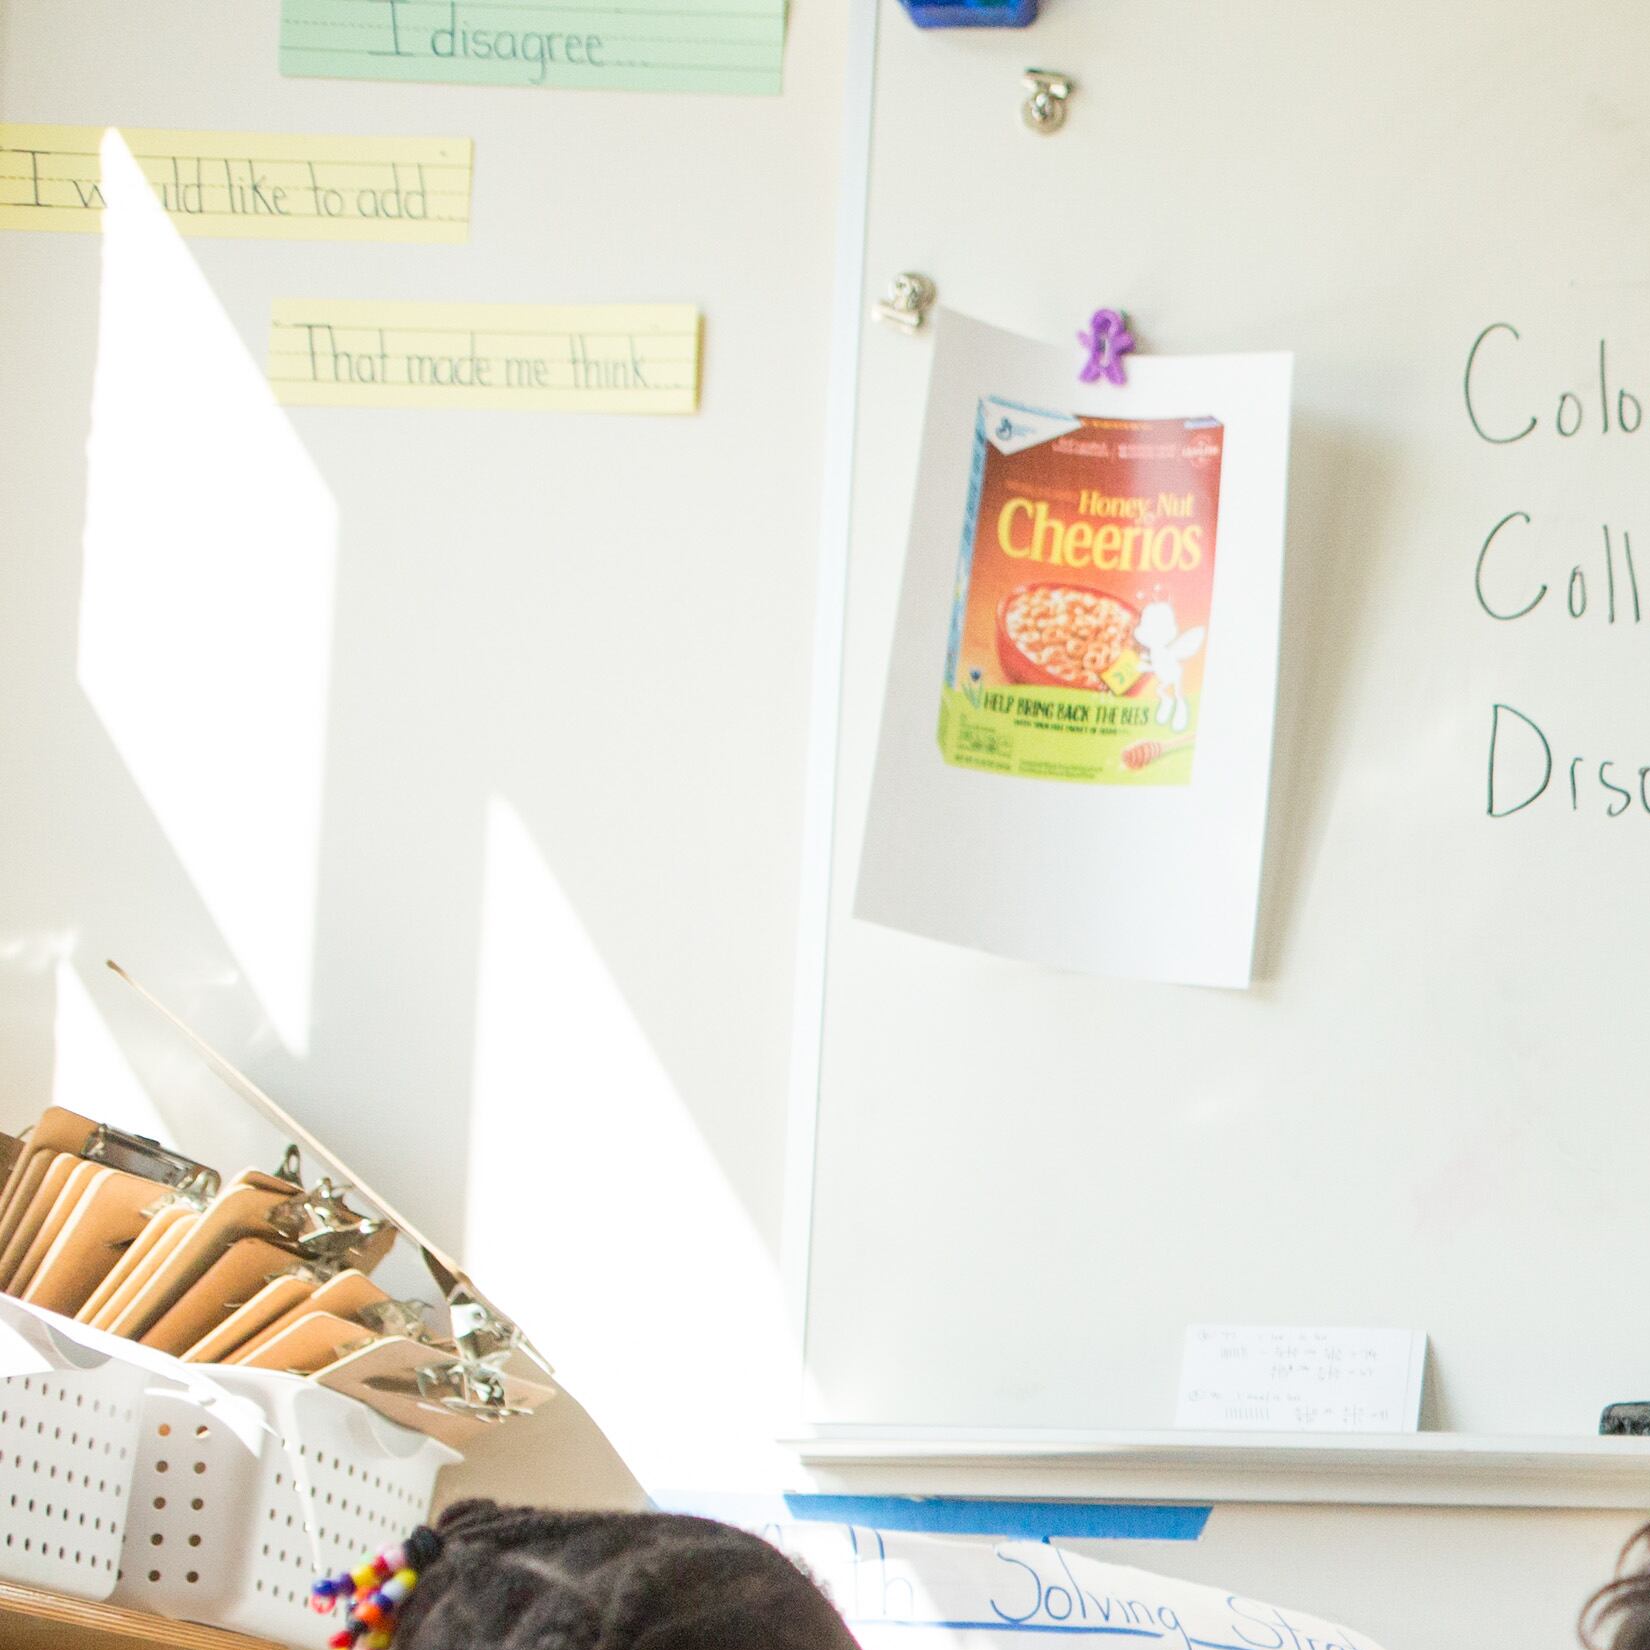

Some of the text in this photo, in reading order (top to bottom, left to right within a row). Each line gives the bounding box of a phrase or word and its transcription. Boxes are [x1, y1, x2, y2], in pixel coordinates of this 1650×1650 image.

[367, 0, 414, 57] I
[10, 149, 52, 207] I
[72, 156, 204, 214] wld
[224, 158, 292, 216] like
[308, 161, 345, 216] to
[293, 323, 390, 384] That
[406, 332, 492, 386] made
[505, 356, 549, 388] me
[997, 496, 1203, 573] Cheerios
[1078, 488, 1194, 522] Honey Nut
[983, 691, 1014, 716] HELP
[1016, 696, 1055, 719] BRING
[1056, 700, 1091, 723] BACK
[1094, 706, 1117, 725] THE
[1120, 706, 1150, 727] BEES
